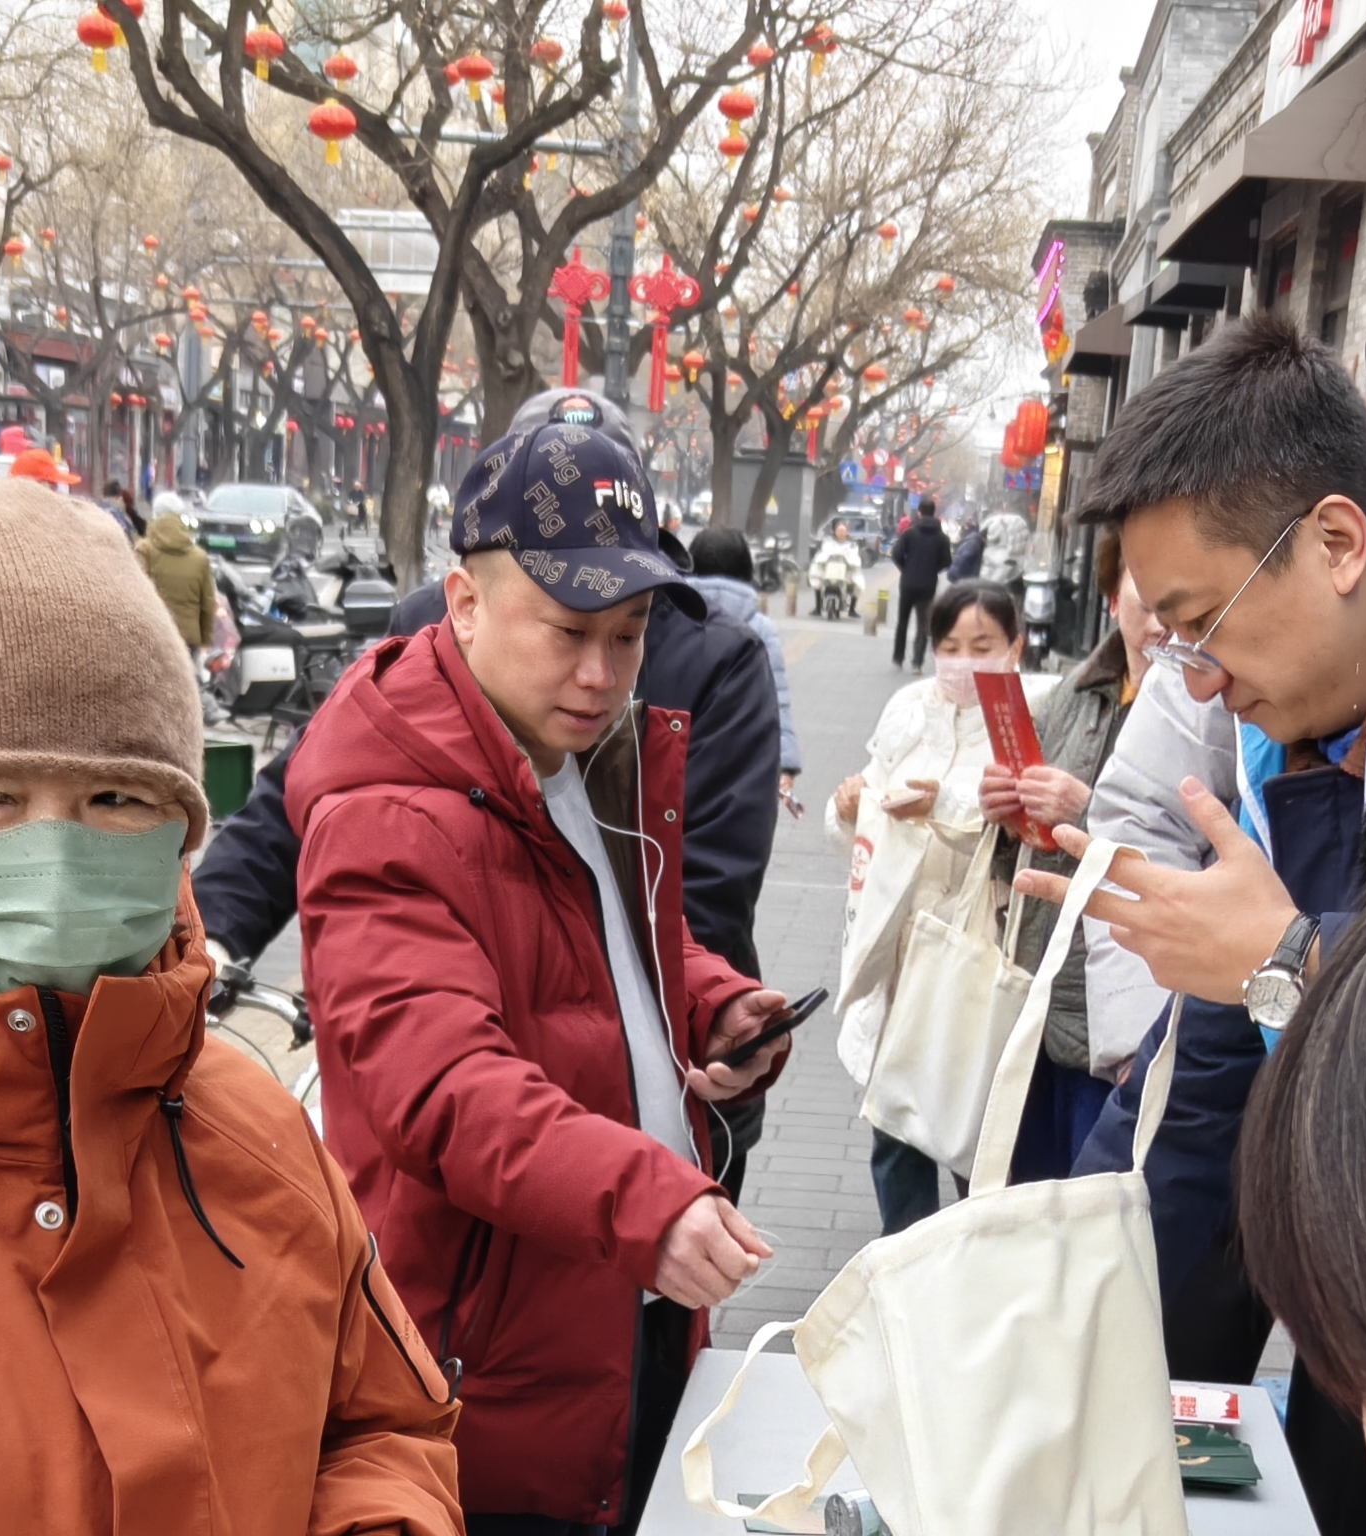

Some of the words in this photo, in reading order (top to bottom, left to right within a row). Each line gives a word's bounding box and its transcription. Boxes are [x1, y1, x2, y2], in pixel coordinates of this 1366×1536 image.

[538, 438, 581, 486] Flig
[524, 480, 567, 539] Flig
[593, 478, 644, 520] Flig
[584, 509, 619, 547] Fli
[520, 549, 568, 585] Flig
[572, 566, 625, 599] Flig
